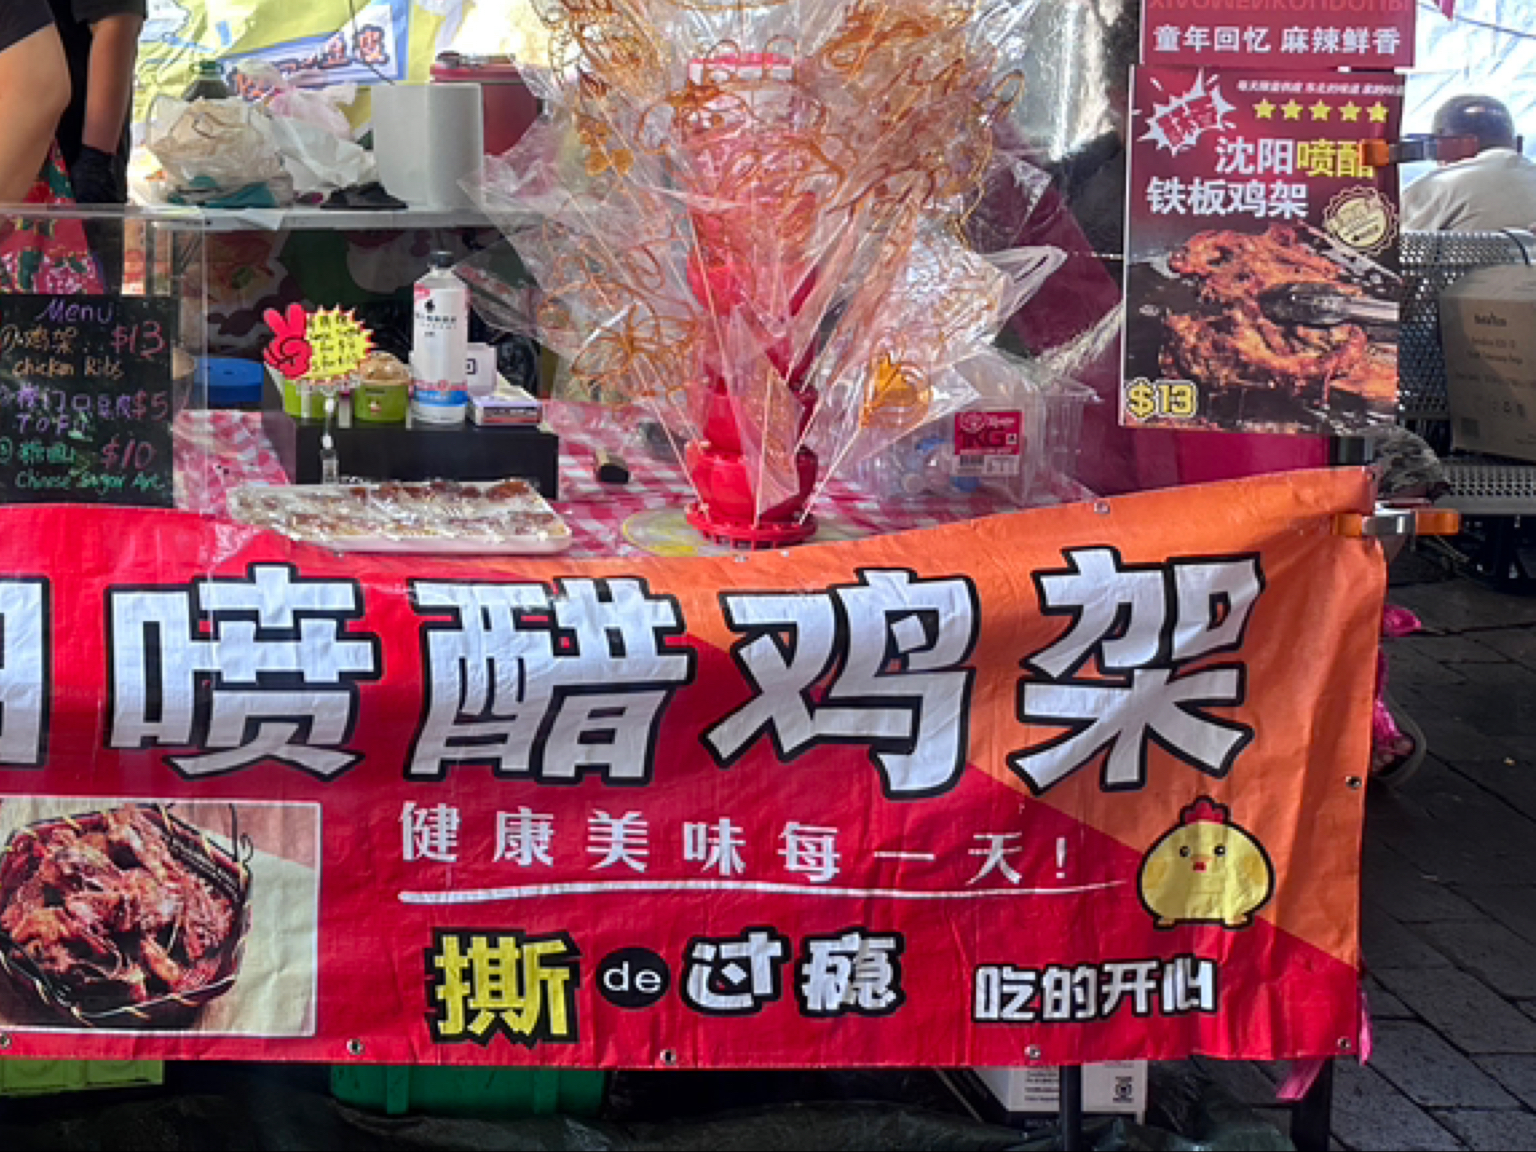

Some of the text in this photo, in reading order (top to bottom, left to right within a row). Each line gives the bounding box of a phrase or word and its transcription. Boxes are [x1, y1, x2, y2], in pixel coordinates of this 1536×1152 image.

[1153, 24, 1401, 55] 童年回忆 麻辣鲜香
[1146, 176, 1310, 219] 铁板鸡架
[35, 298, 113, 324] Menu
[110, 320, 167, 360] $13
[1127, 379, 1197, 420] $13
[101, 436, 157, 471] $10
[430, 928, 1220, 1044] 撕 de 过瘾 吃的开心
